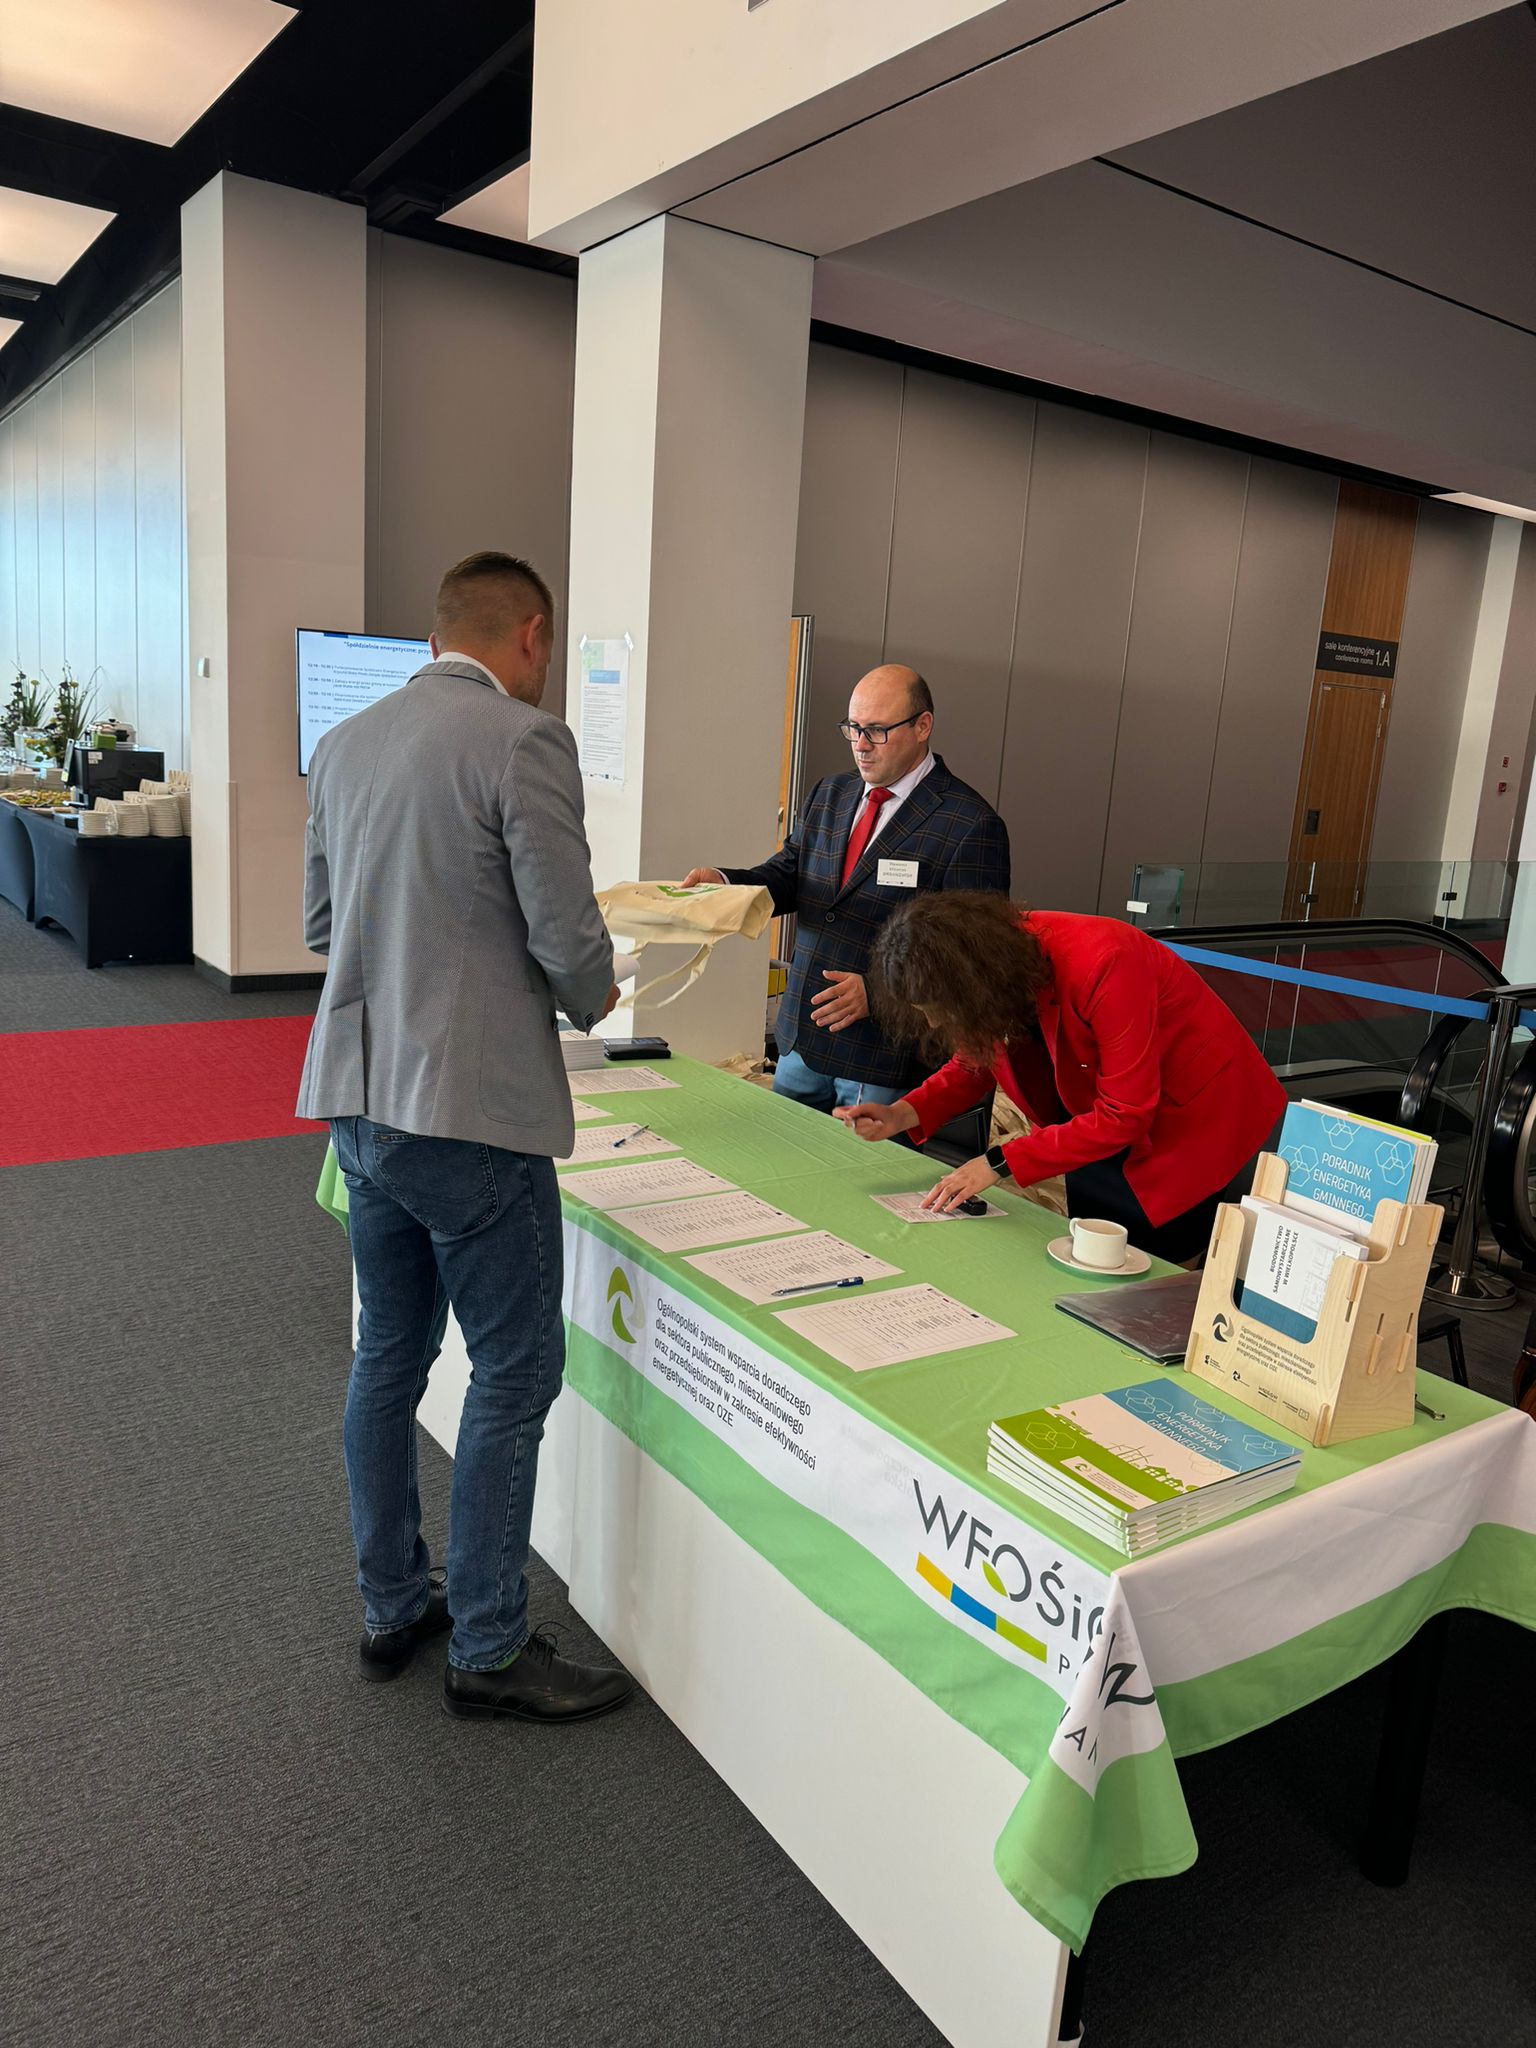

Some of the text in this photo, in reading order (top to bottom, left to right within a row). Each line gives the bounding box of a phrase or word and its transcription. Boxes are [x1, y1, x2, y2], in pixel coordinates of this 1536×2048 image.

[1325, 641, 1375, 657] sale konferencyjne
[1335, 654, 1359, 663] conference
[1375, 650, 1390, 667] 1.A
[1312, 1168, 1371, 1201] ENERGETYKA
[1321, 1152, 1373, 1181] PORADNIK
[1312, 1188, 1365, 1218] GMINNEGO
[1269, 1225, 1283, 1273] BUDOWNICTWO
[1273, 1229, 1291, 1294] SAMOWYSTARCZALNE
[1284, 1231, 1299, 1278] WIELKOPOLSCE
[657, 1297, 811, 1416] Ogólnopolski system wsparcia doradczego
[652, 1356, 734, 1428] energetycznej oraz OZE
[655, 1317, 804, 1435] dla sektora publicznego, mieszkaniowego
[654, 1338, 817, 1470] oraz przedsiębiorstw w zakresie efektywności
[1147, 1419, 1206, 1454] GMINNEGO
[1156, 1412, 1222, 1451] ENERGETYKA
[1175, 1411, 1232, 1444] PORADNIK
